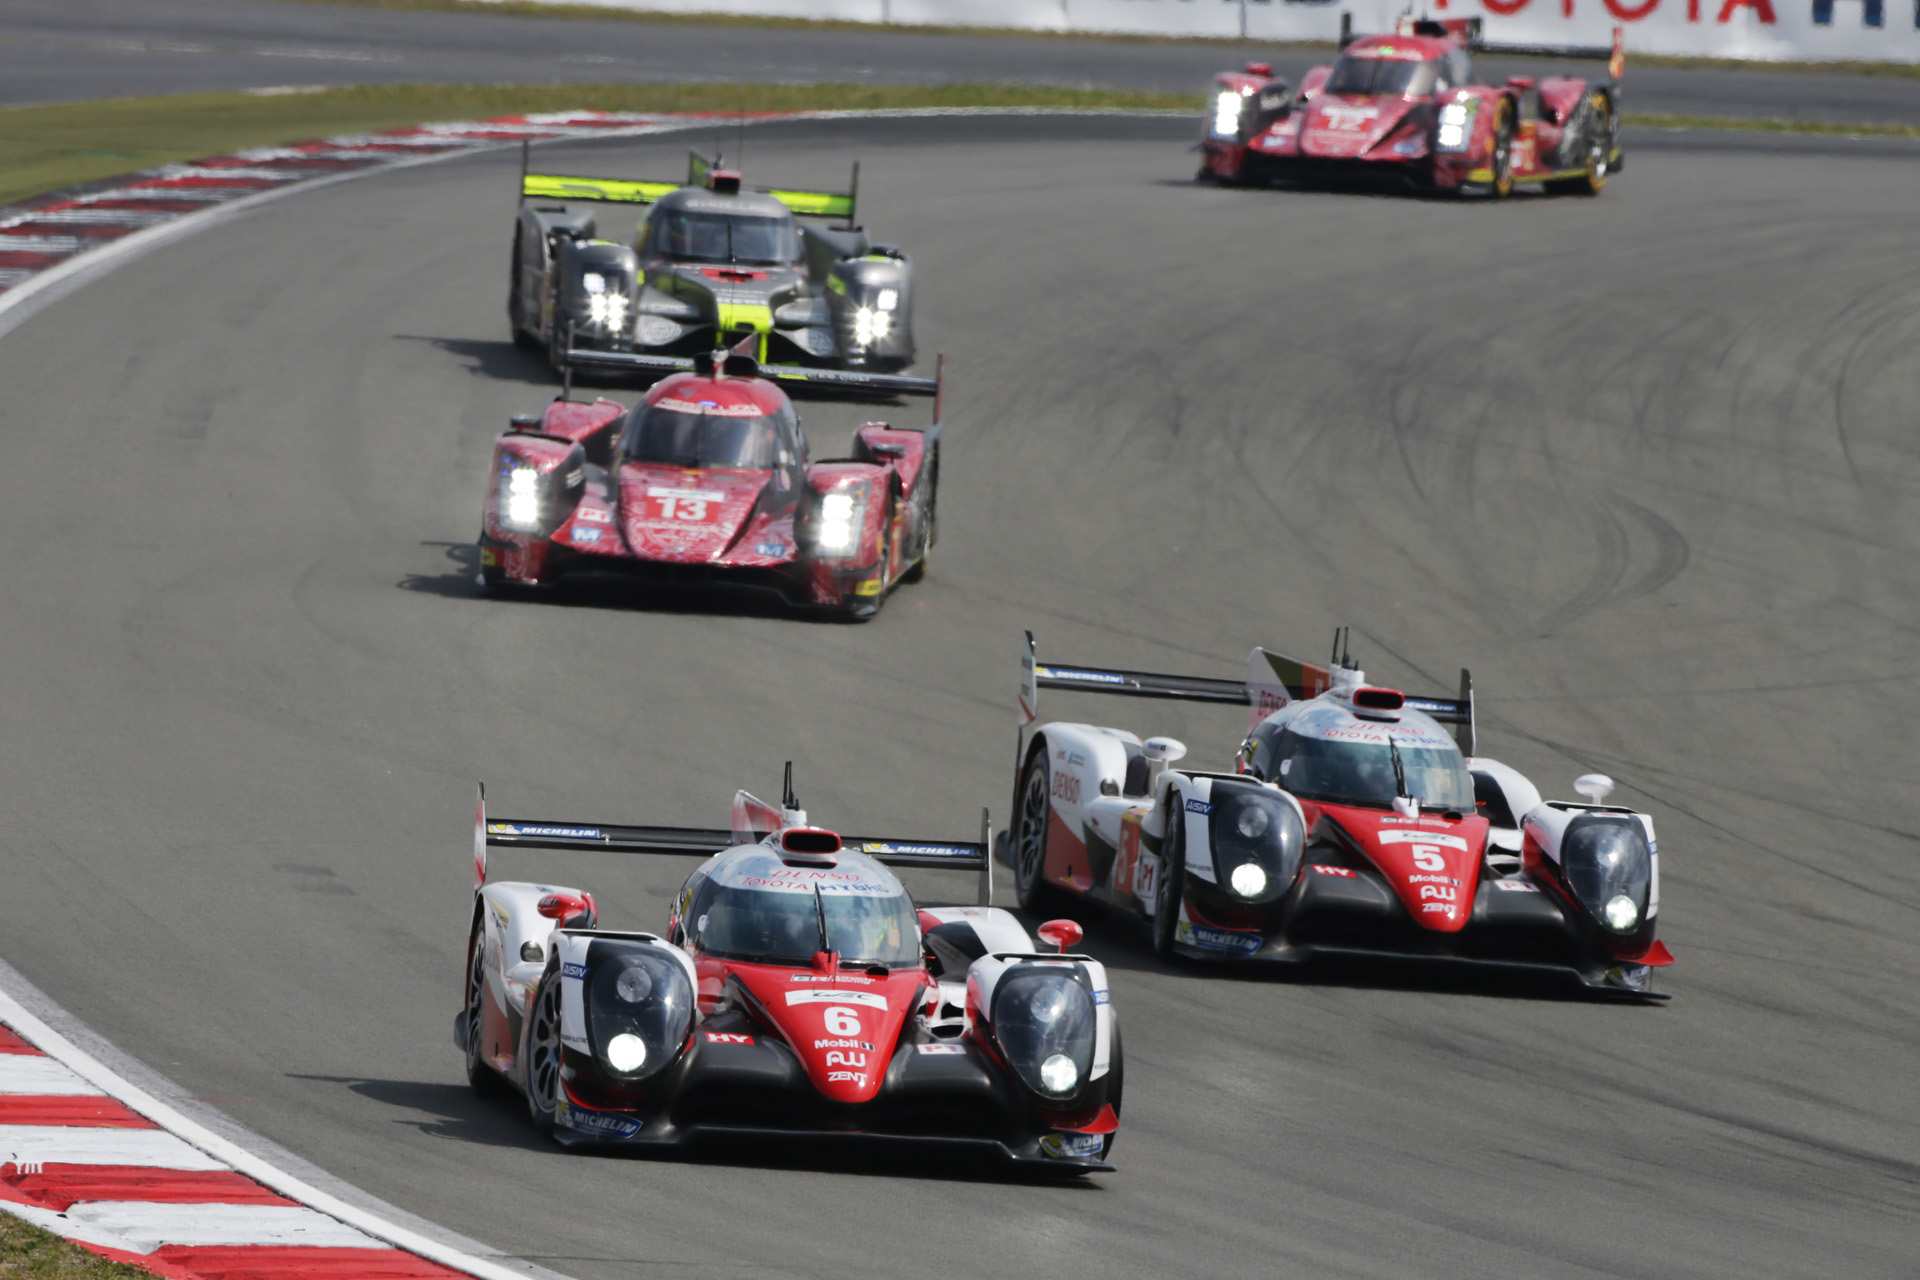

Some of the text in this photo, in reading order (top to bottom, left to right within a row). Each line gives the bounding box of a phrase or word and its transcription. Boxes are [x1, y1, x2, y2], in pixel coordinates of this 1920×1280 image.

[656, 497, 708, 522] 13
[1321, 728, 1383, 742] TOYOTA
[1348, 723, 1425, 736] DENSO
[1053, 770, 1082, 804] DENSO
[1186, 801, 1213, 814] AISIN
[521, 826, 597, 837] MICHELIN
[897, 845, 971, 856] MICHELIN
[1412, 844, 1445, 871] 5
[771, 870, 860, 881] DENSO
[1313, 864, 1350, 877] HY
[741, 876, 889, 894] TOYOTA HYBRID
[1409, 874, 1449, 884] Mobil
[1421, 902, 1458, 913] ZENT
[1197, 930, 1258, 951] MICHELIN
[562, 964, 587, 978] AISIN
[823, 1006, 862, 1037] 6
[708, 1033, 749, 1043] HY
[814, 1038, 858, 1049] Mobil
[827, 1070, 868, 1082] ZENT
[574, 1111, 637, 1134] MICHELIN
